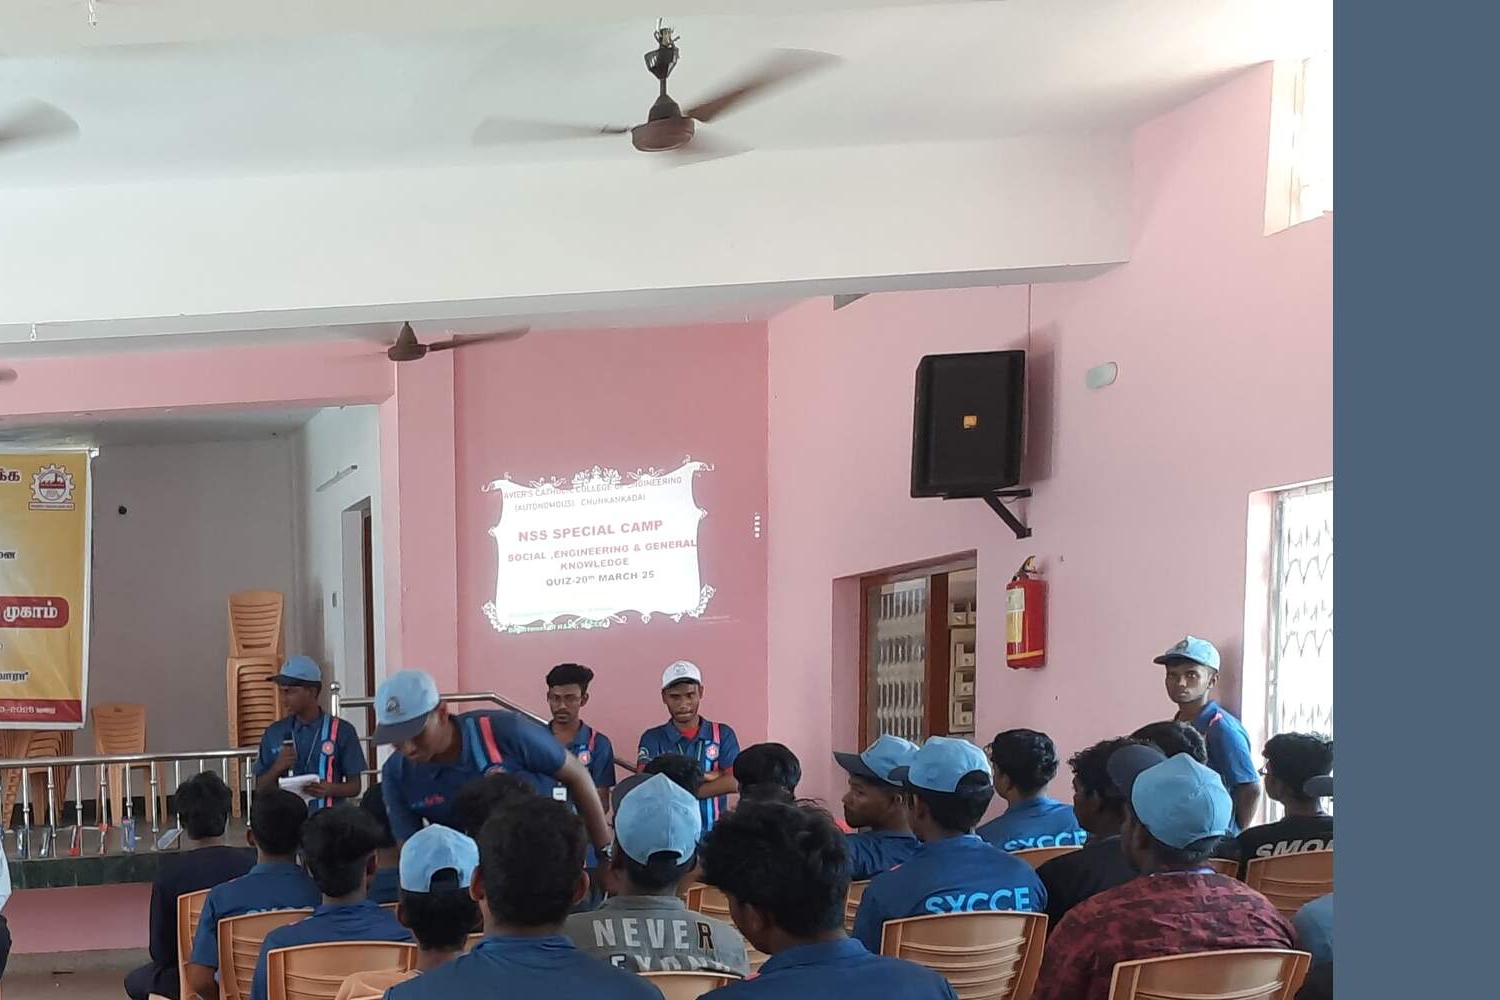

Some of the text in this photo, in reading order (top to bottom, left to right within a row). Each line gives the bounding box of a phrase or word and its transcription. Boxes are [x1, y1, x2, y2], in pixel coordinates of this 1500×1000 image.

[518, 520, 663, 542] NSS SPECIAL CAMP
[508, 552, 547, 562] SOCIAL
[633, 544, 641, 552] &
[645, 539, 698, 551] GENERAL
[560, 557, 629, 570] KNOWLEDGE
[598, 571, 638, 582] MARCH
[641, 570, 654, 579] 25
[4, 600, 58, 622] முகாம்
[1256, 839, 1333, 858] SMO
[925, 887, 1032, 914] SXCCE
[592, 918, 714, 950] NEVER
